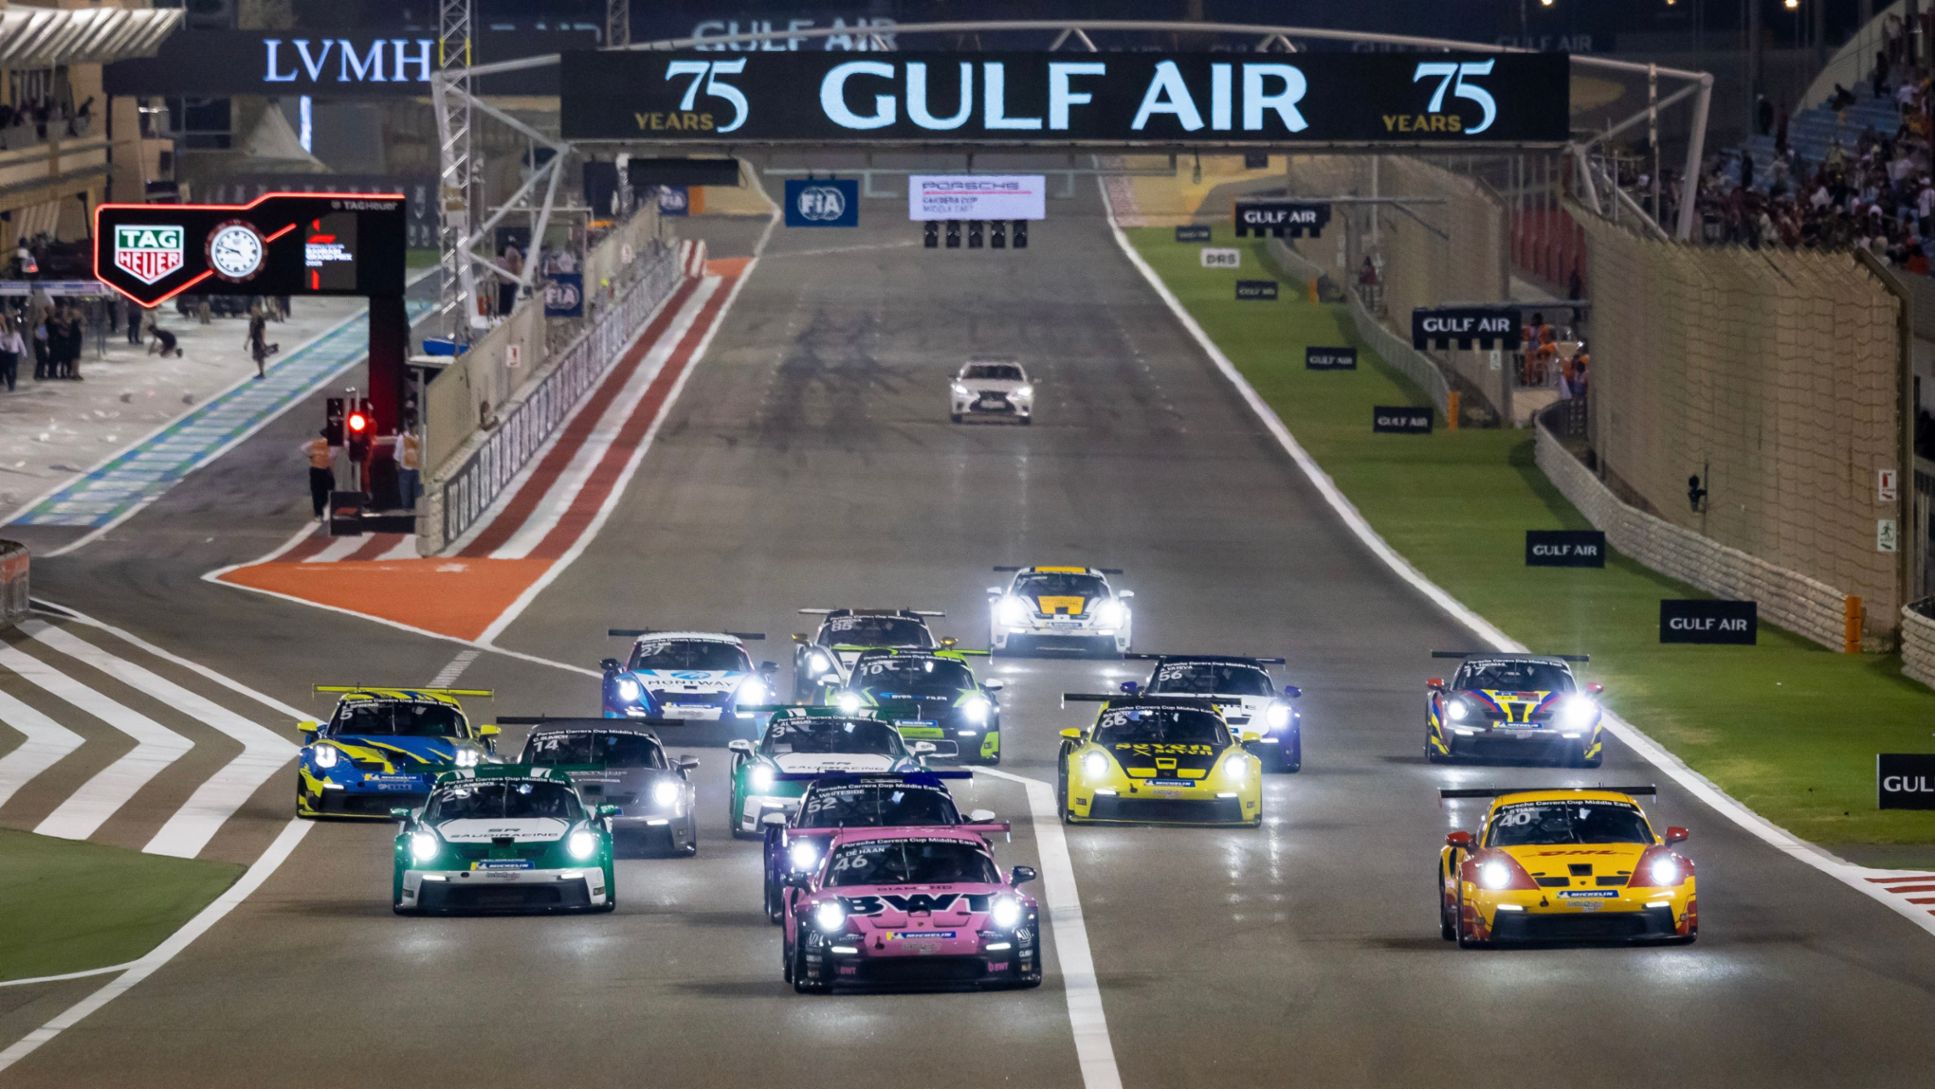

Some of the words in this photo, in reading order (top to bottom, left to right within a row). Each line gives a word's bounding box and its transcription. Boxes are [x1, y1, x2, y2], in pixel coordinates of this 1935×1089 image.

[263, 39, 435, 82] LVMH
[664, 57, 749, 133] 75
[819, 60, 1105, 130] GULF
[1131, 58, 1308, 131] AIR
[1412, 57, 1497, 134] 75
[634, 112, 714, 131] YEARS
[1382, 113, 1462, 132] YEARS
[922, 182, 1019, 190] PORSCHE
[1244, 211, 1287, 223] GULF
[1289, 210, 1317, 223] AIR
[121, 230, 178, 248] TAG
[1206, 254, 1236, 264] DRS
[118, 252, 180, 281] HEUER
[1423, 318, 1475, 332] GULF
[1478, 317, 1510, 332] AIR
[1377, 416, 1407, 426] GULF
[1409, 417, 1428, 427] AIR
[1532, 545, 1571, 556] GULF
[1573, 545, 1598, 556] AIR
[1669, 617, 1715, 630] GULF
[1718, 618, 1747, 631] AIR
[641, 646, 664, 657] 27
[860, 664, 883, 676] 10
[1159, 670, 1183, 681] 56
[1464, 665, 1486, 677] 17
[339, 708, 353, 720] 5
[1101, 714, 1127, 728] 66
[771, 726, 785, 738] 3
[533, 739, 559, 752] 14
[1883, 775, 1935, 792] GUL
[807, 797, 838, 813] 52
[1502, 801, 1535, 810] Porsche
[1498, 812, 1531, 827] 40
[842, 840, 876, 848] Porsche
[928, 837, 957, 845] Middle
[959, 839, 977, 847] East
[834, 855, 868, 871] 46
[834, 892, 998, 917] BWT
